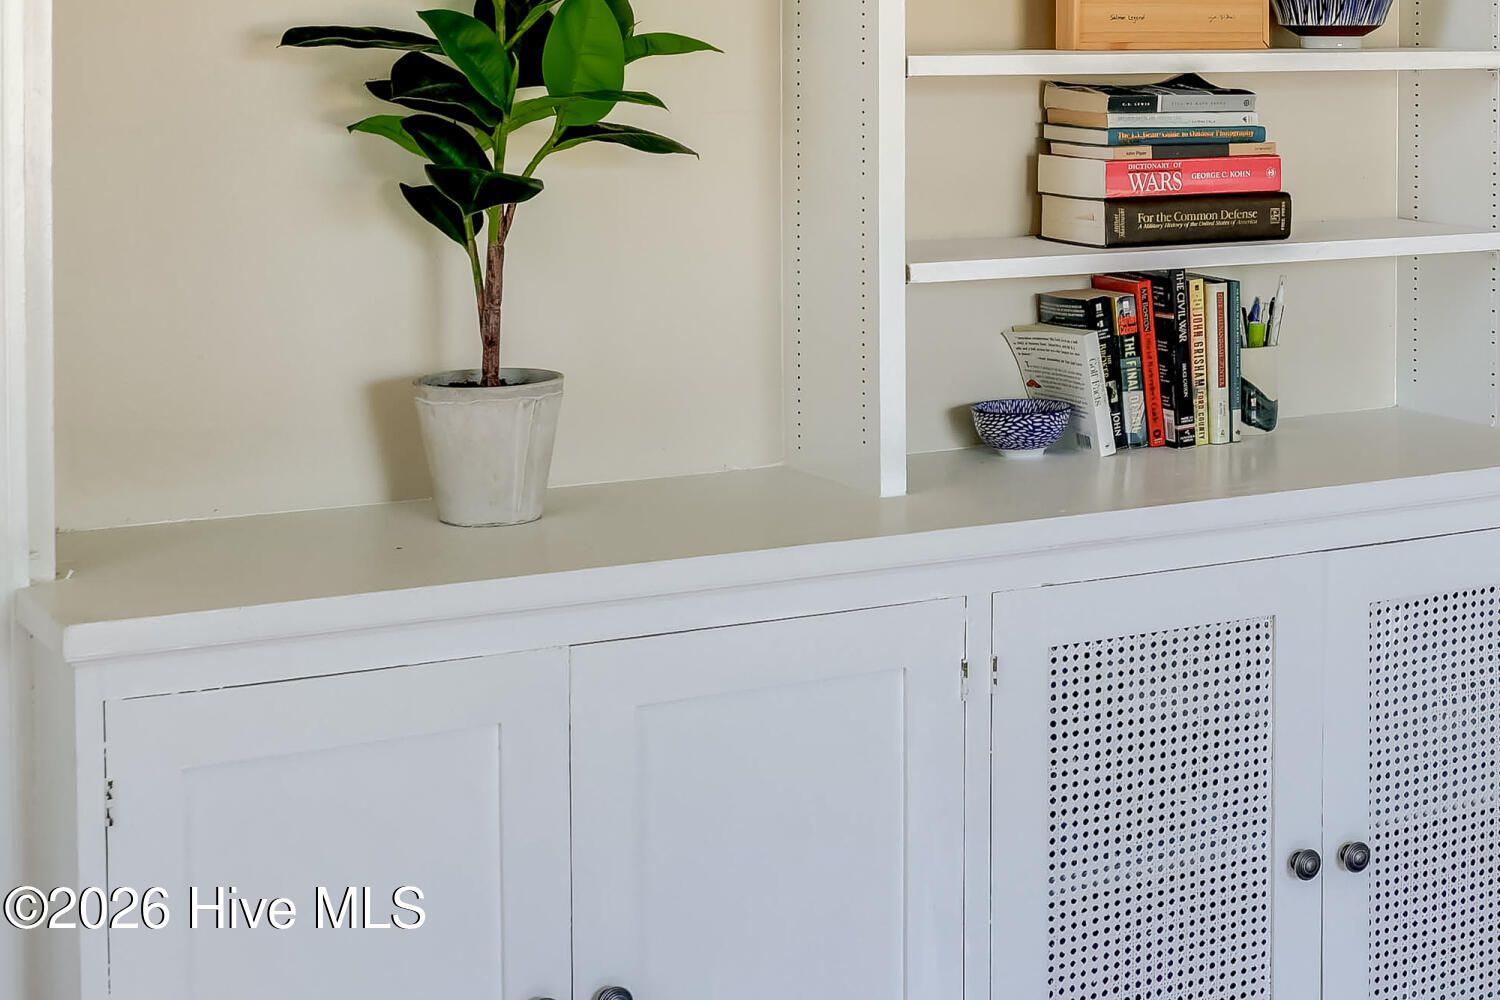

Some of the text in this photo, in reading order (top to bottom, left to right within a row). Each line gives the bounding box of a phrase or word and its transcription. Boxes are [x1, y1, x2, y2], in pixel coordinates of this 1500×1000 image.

[1128, 163, 1170, 171] DICTIONARY
[1191, 170, 1252, 180] GEORGE C. KOHN
[1128, 171, 1183, 193] WARS
[1138, 209, 1258, 224] For the Common Defense
[1143, 222, 1164, 230] Military
[1164, 222, 1184, 230] History
[1142, 302, 1151, 332] BOSTON
[1176, 270, 1187, 343] THE CIVIL WAR
[1088, 357, 1102, 407] Golf Facts
[1124, 335, 1142, 433] THE FINAL DETAIL
[1193, 313, 1206, 439] JOHN GRISHAM FORD COUNTY
[1110, 412, 1122, 437] JOHN
